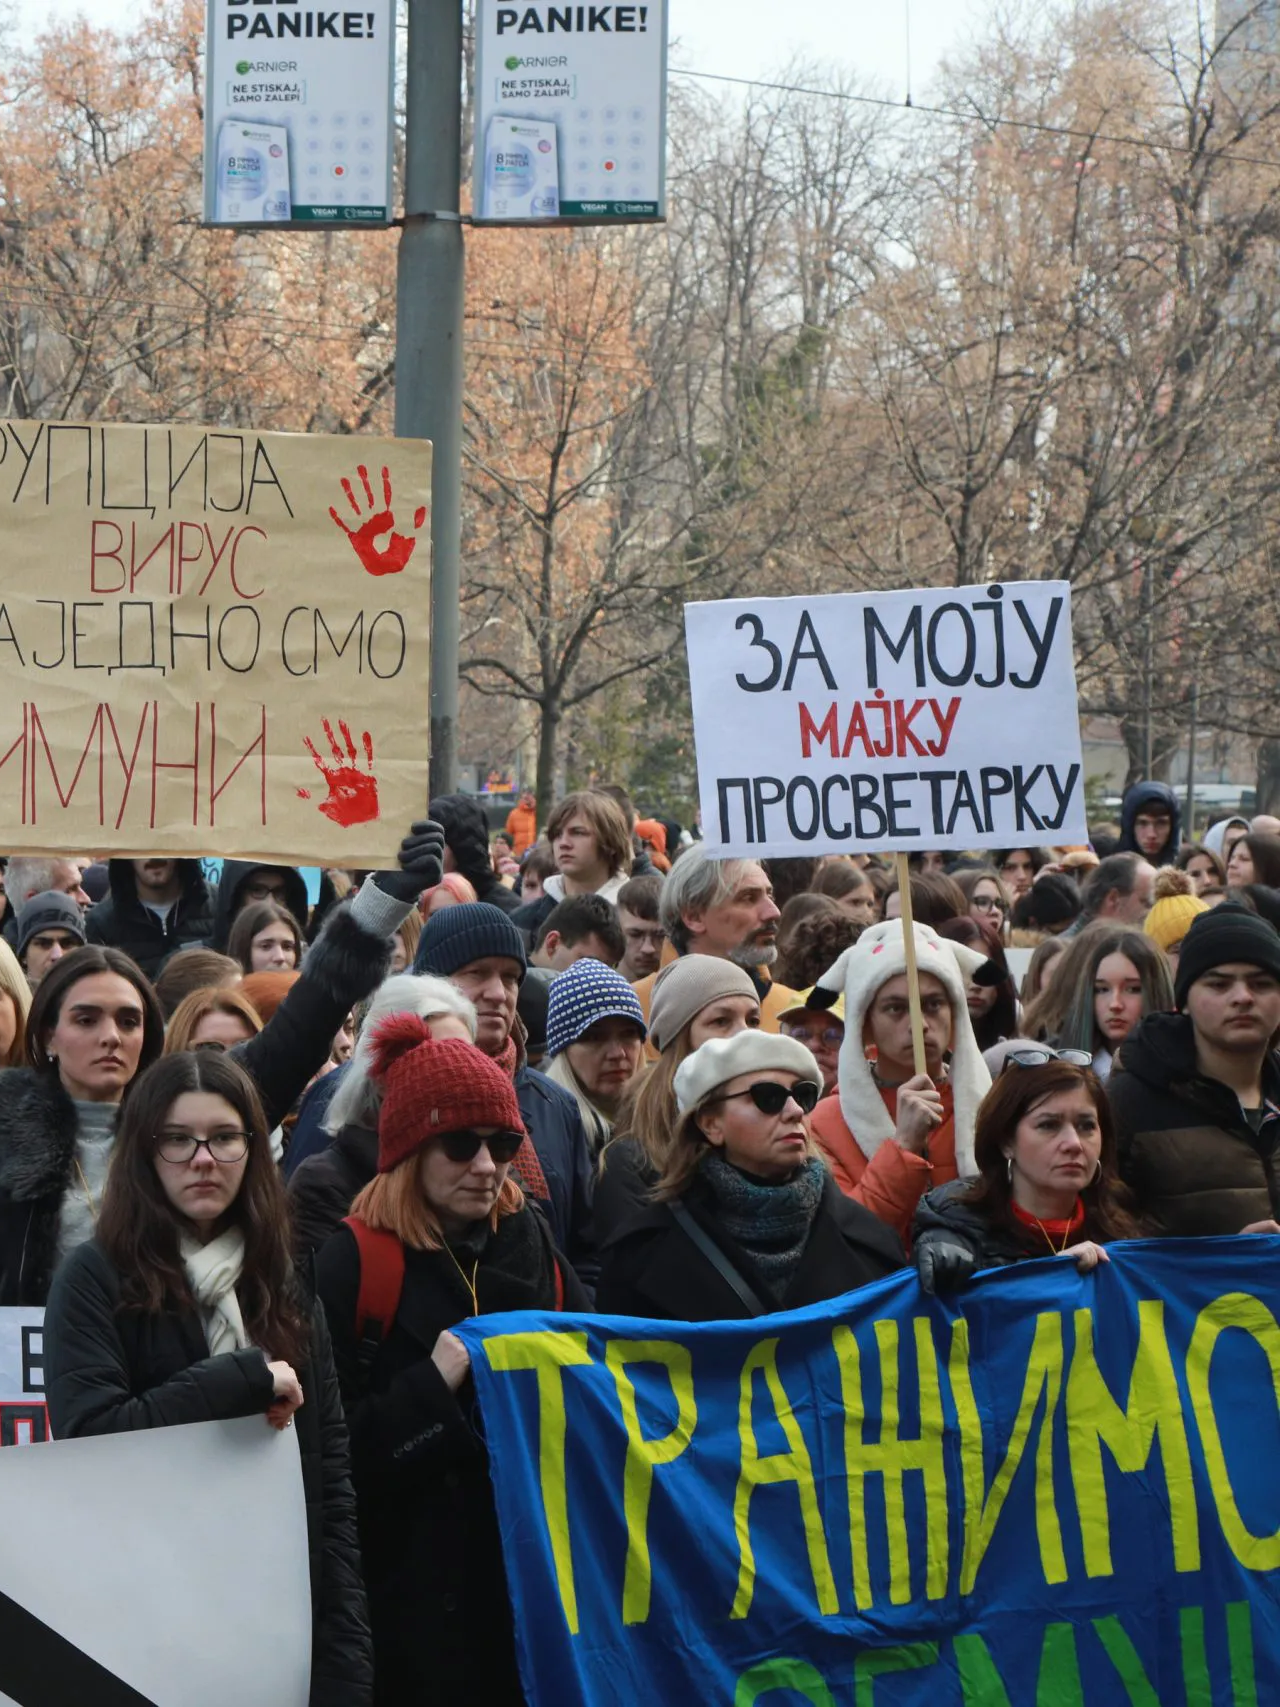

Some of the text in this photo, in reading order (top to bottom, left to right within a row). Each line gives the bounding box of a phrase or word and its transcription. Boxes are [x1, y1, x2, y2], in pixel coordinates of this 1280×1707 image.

[227, 12, 375, 39] PANIKE!
[496, 6, 648, 35] PANIKE!
[233, 83, 300, 93] NE STISKAJ,
[501, 78, 570, 89] NE STISKAJ,
[233, 93, 300, 103] SAMO ZALEPI
[502, 88, 570, 99] SAMO ZALEPI
[228, 156, 236, 168] 8
[496, 152, 504, 164] 8
[91, 520, 267, 599] ВИРУС
[281, 605, 407, 679] СМО
[735, 609, 838, 692] ЗА
[717, 763, 1081, 844] ПРОСВЕТАРКУ
